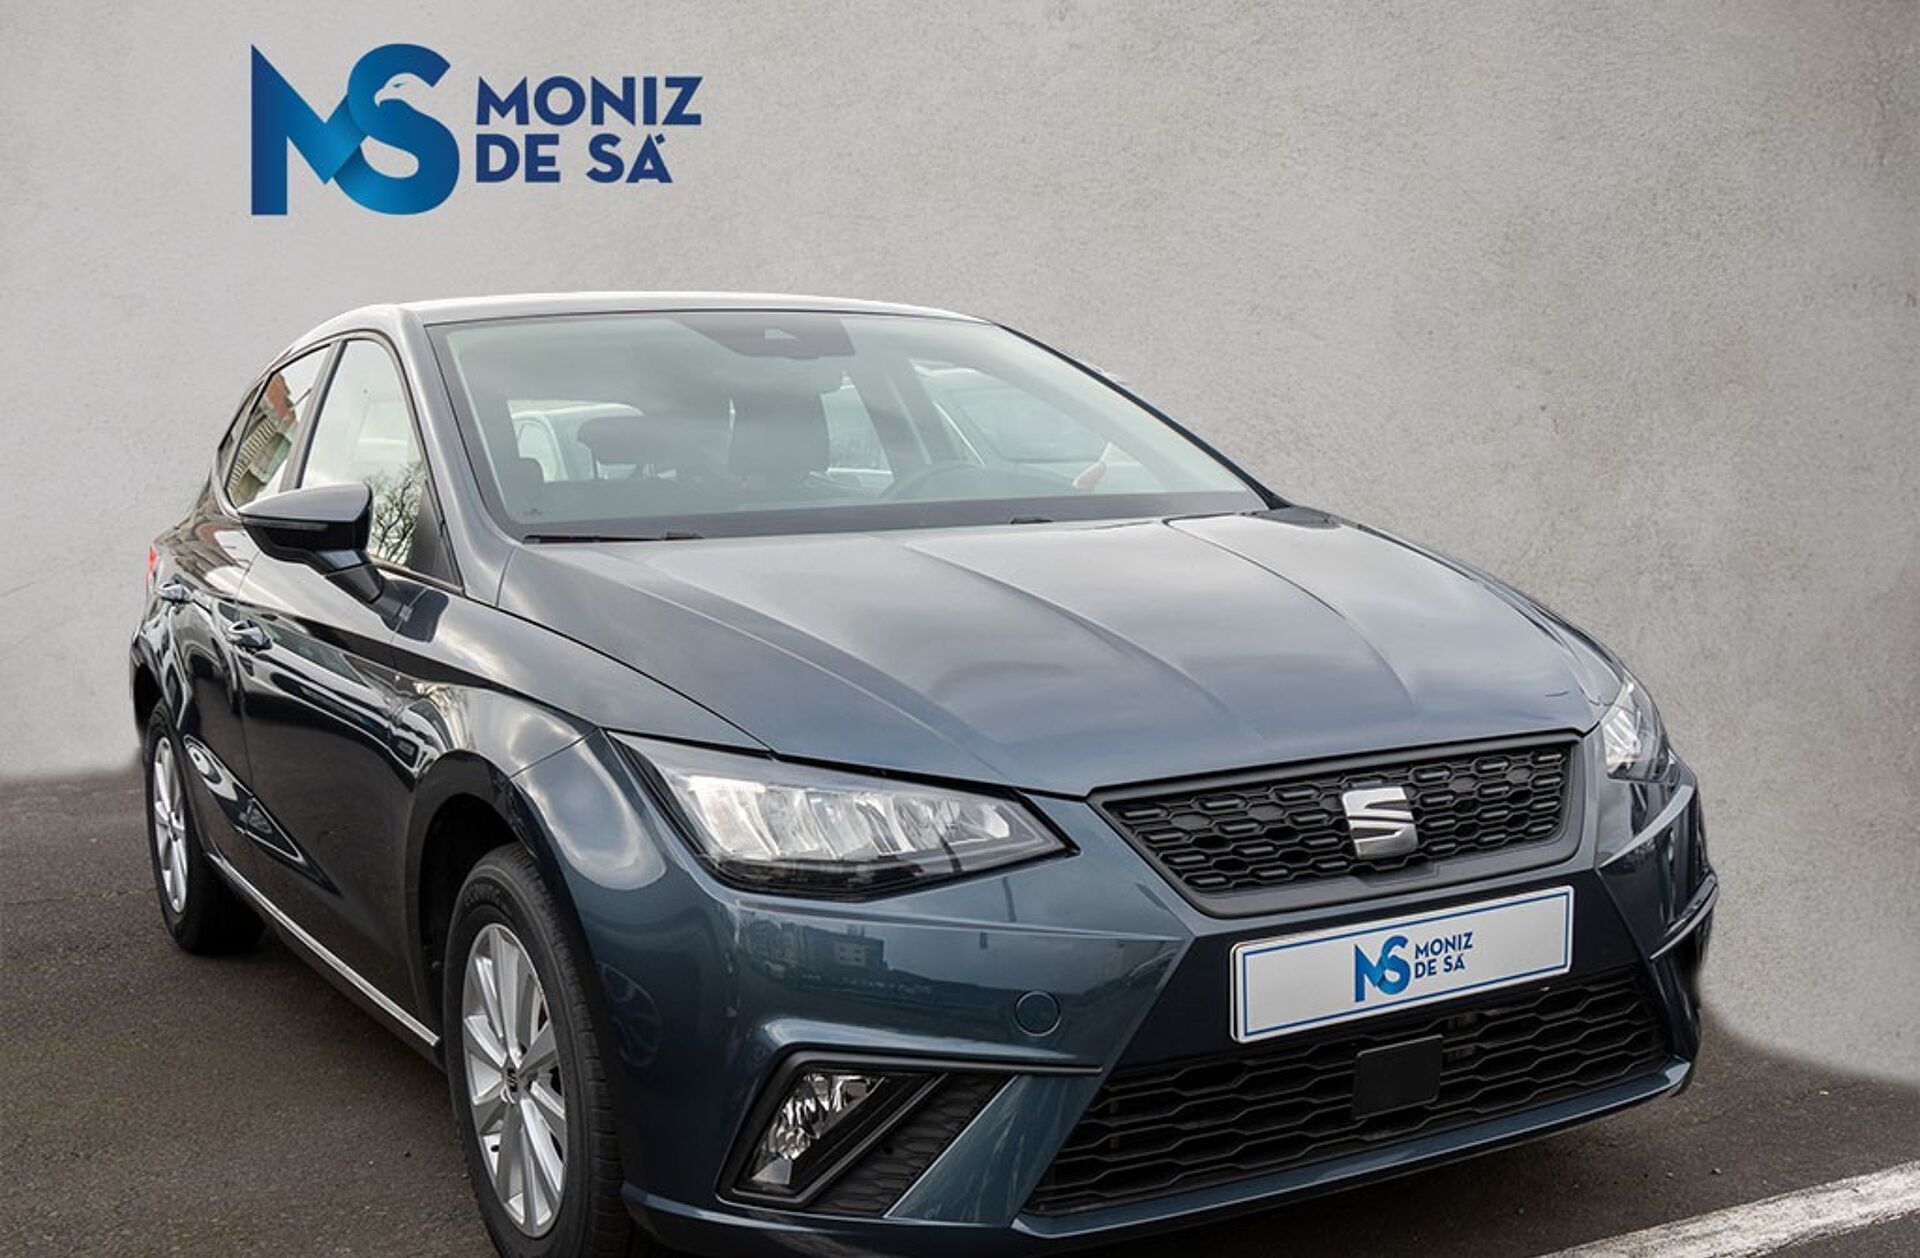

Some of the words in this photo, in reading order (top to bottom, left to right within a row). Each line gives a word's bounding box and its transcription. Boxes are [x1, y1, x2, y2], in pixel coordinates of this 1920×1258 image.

[1414, 932, 1473, 960] MONIZ
[1414, 962, 1437, 979] DE
[1443, 955, 1466, 973] SÁ
